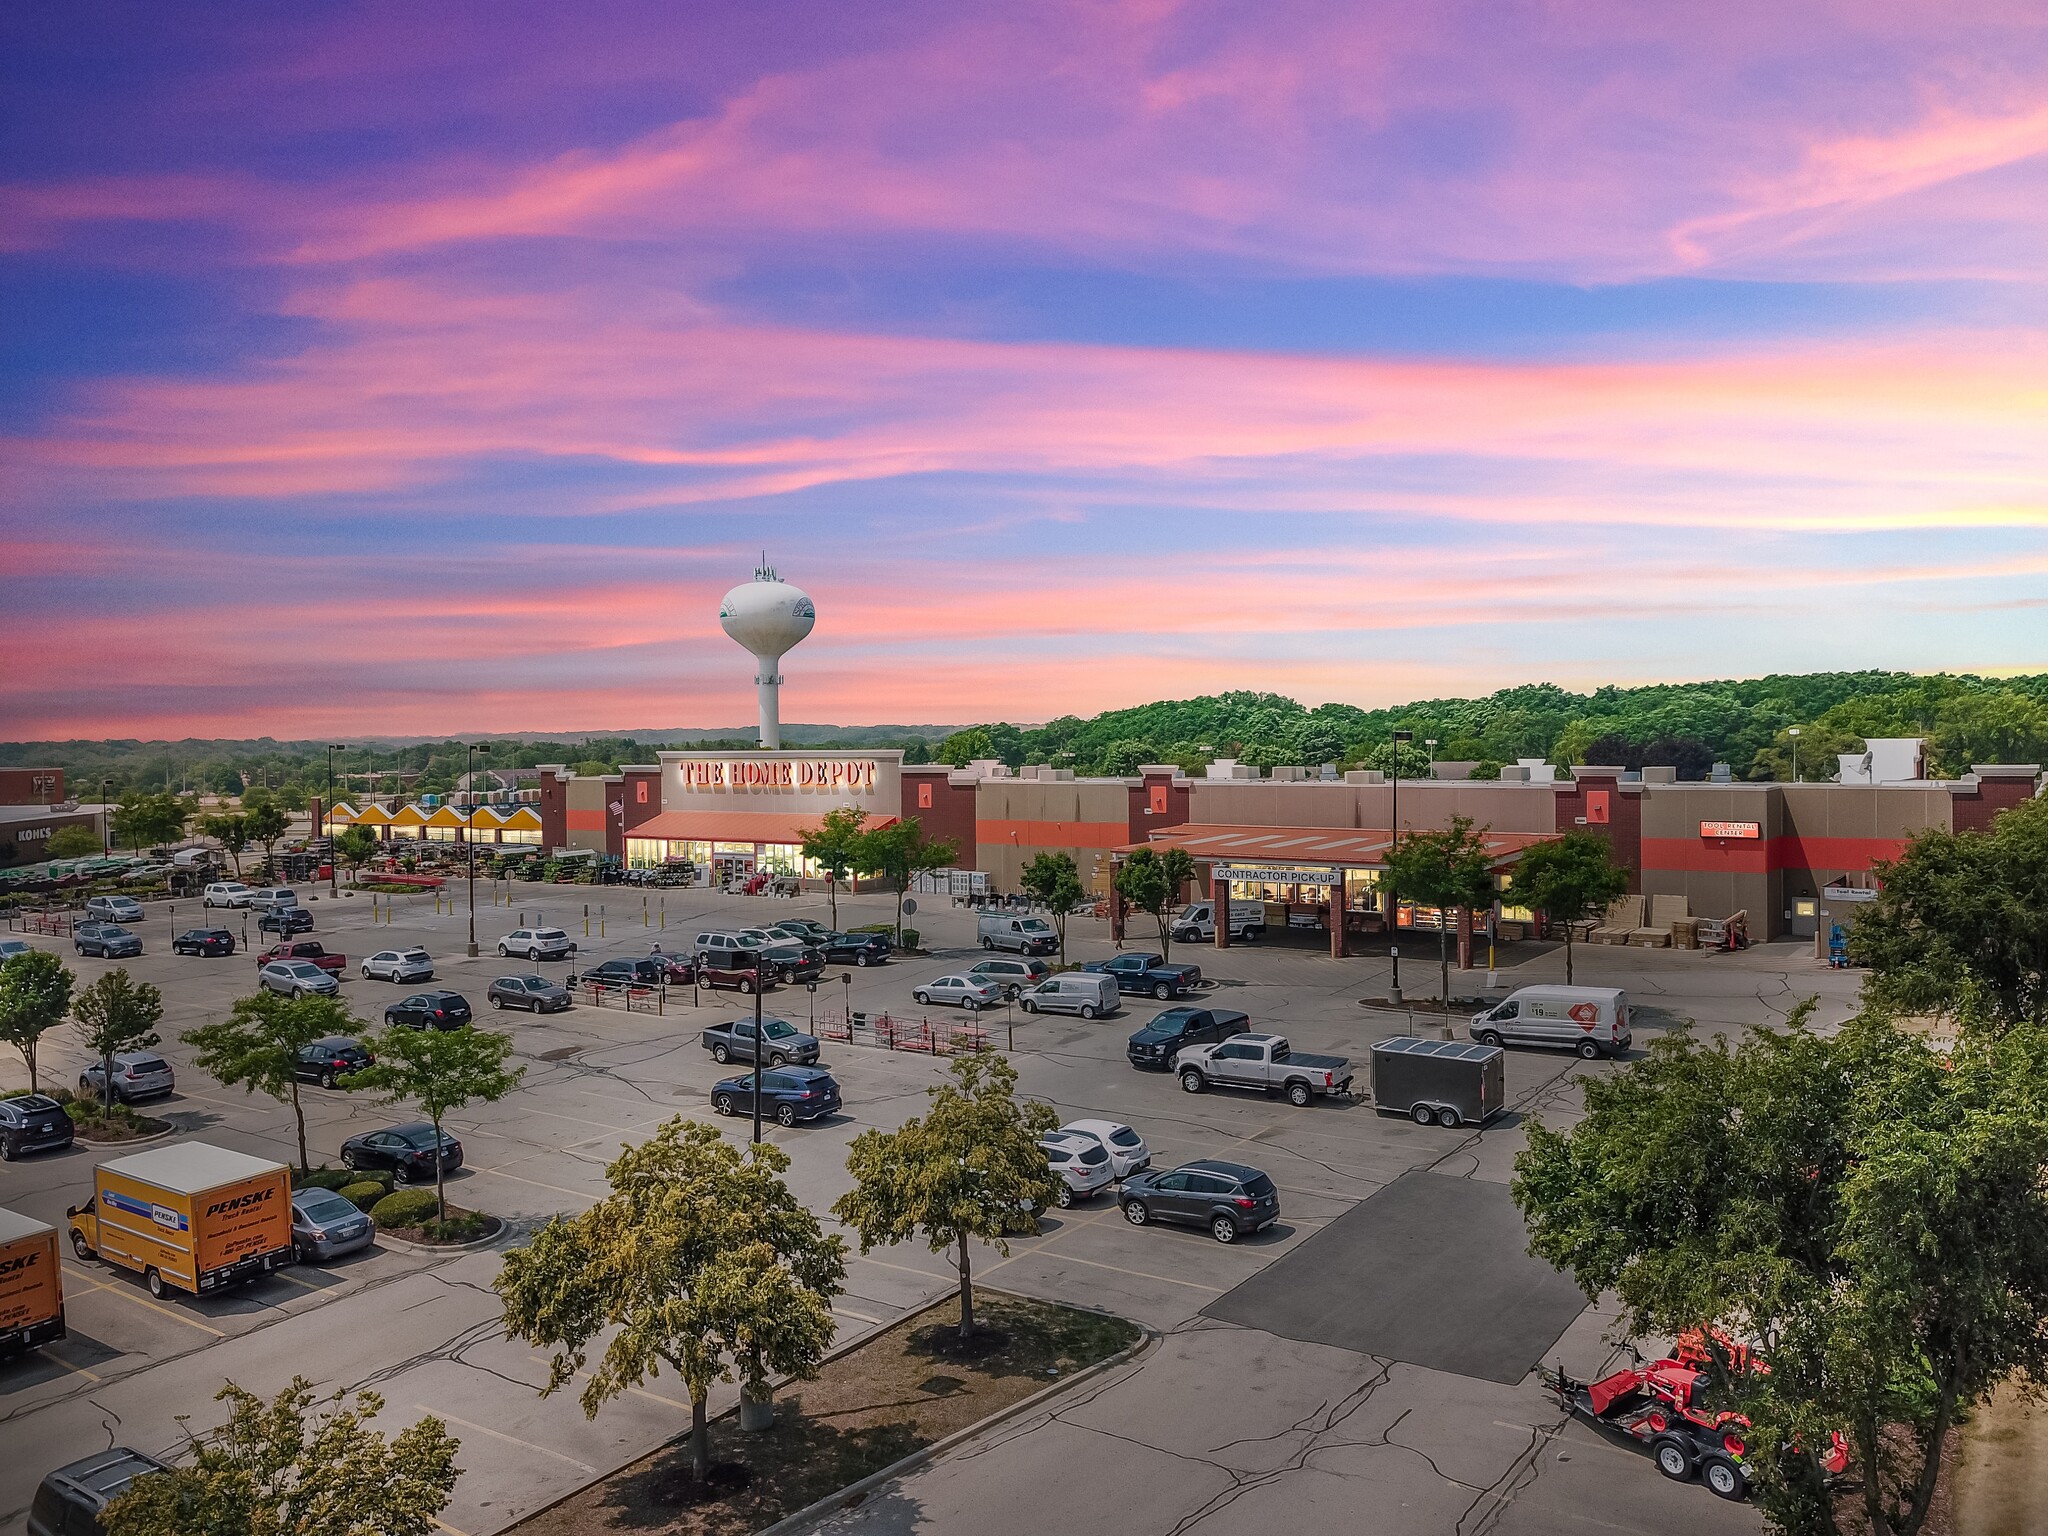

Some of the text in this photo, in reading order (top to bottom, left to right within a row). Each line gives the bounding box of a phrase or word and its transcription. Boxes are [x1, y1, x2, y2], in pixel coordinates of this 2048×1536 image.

[680, 761, 875, 786] THE HOME DEPOT
[18, 827, 52, 842] KOHL'S
[1217, 869, 1335, 883] CONTRACTOR PICK-UP
[205, 1187, 276, 1218] PENSKE
[154, 1210, 177, 1224] PENSKE
[222, 1204, 263, 1222] Truck Rental
[0, 1252, 41, 1275] SKE
